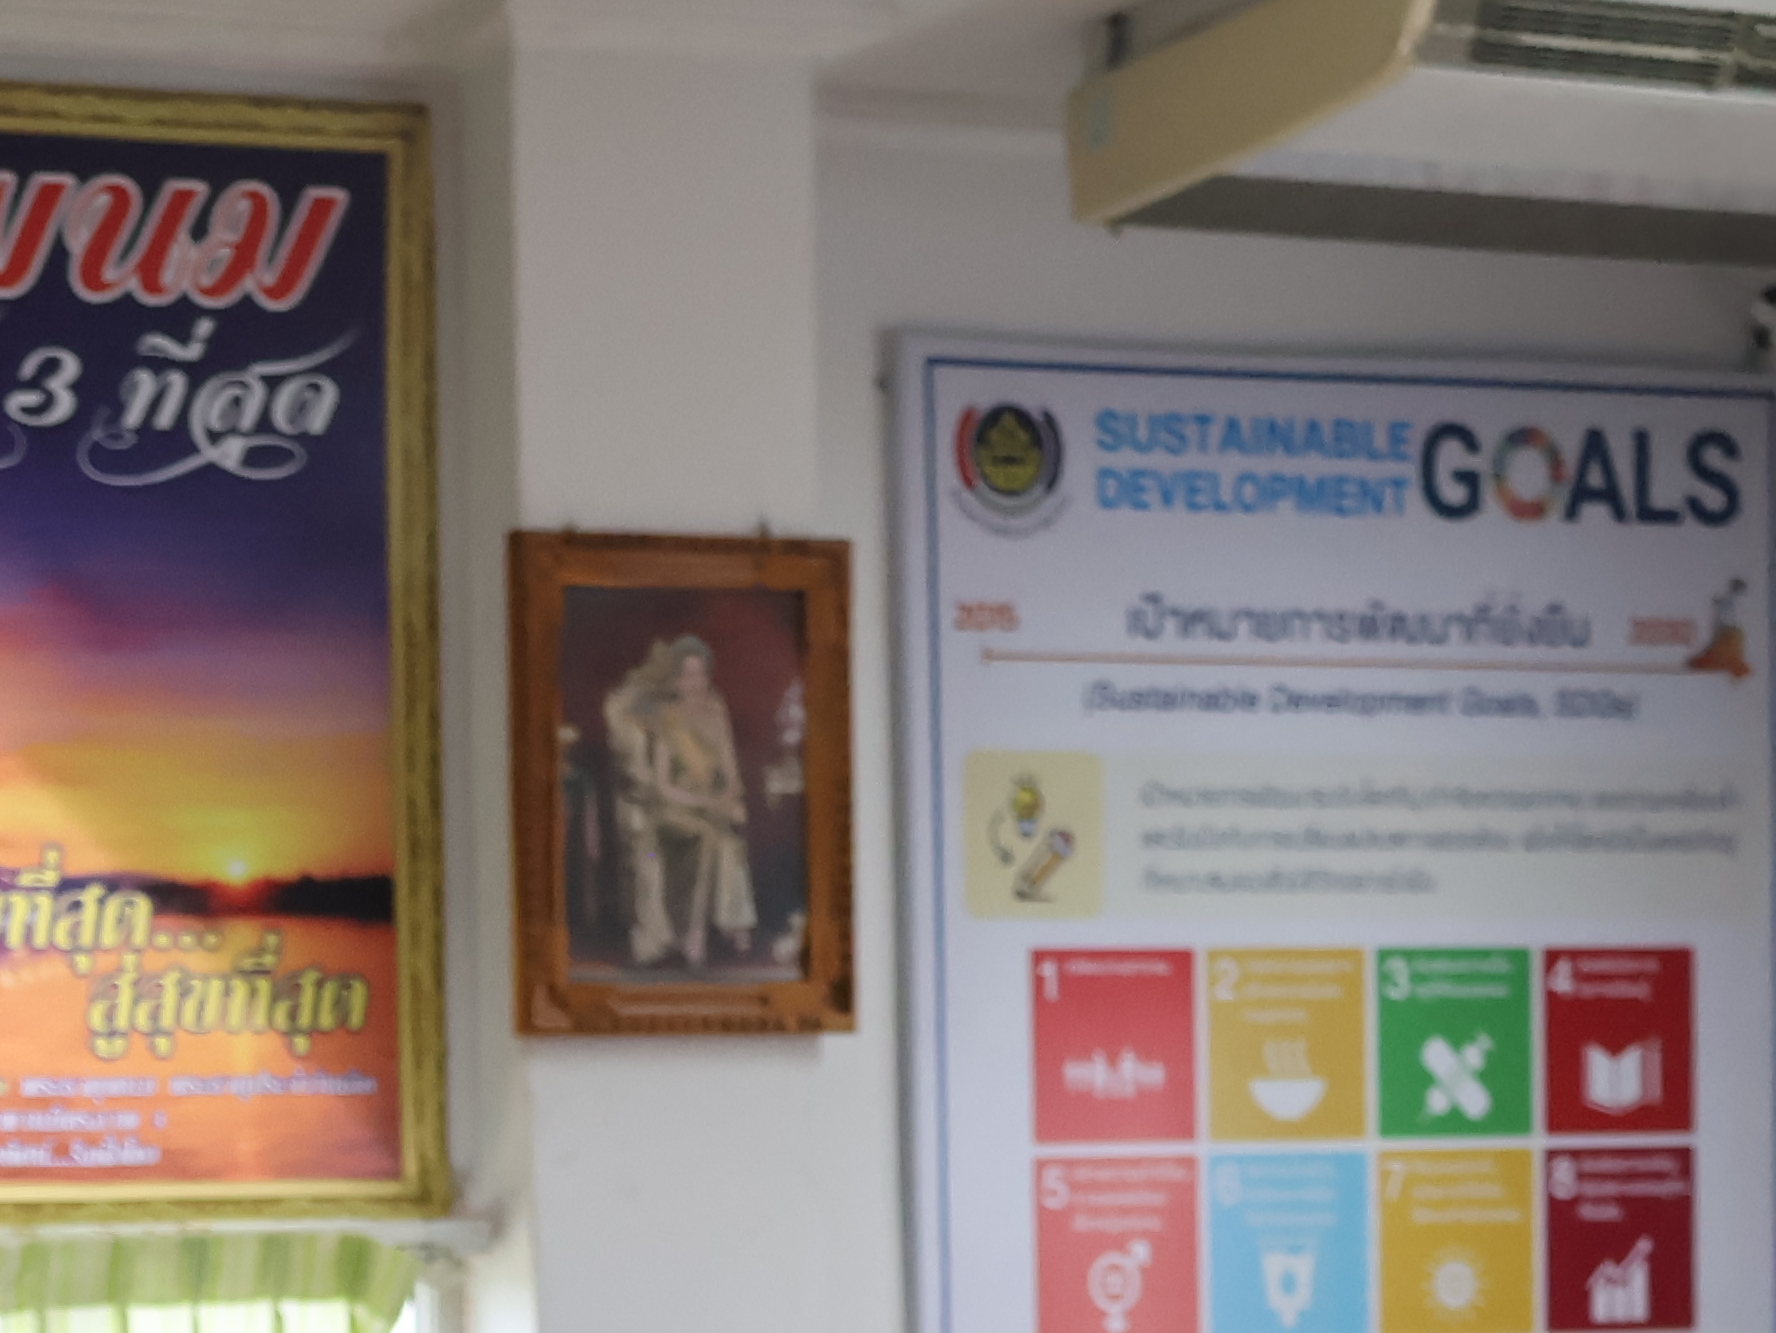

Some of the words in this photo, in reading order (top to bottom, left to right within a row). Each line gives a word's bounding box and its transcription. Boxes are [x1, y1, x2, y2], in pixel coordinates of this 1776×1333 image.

[2, 345, 84, 427] 3
[1094, 408, 1415, 464] SUSTAINABLE
[1095, 466, 1409, 518] DEVELOPMENT
[1420, 420, 1744, 527] GOALS
[1036, 957, 1060, 1002] 1
[1214, 956, 1242, 1000] 2
[1382, 956, 1412, 1000] 3
[1548, 957, 1575, 996] 4
[1042, 1164, 1070, 1210] 5
